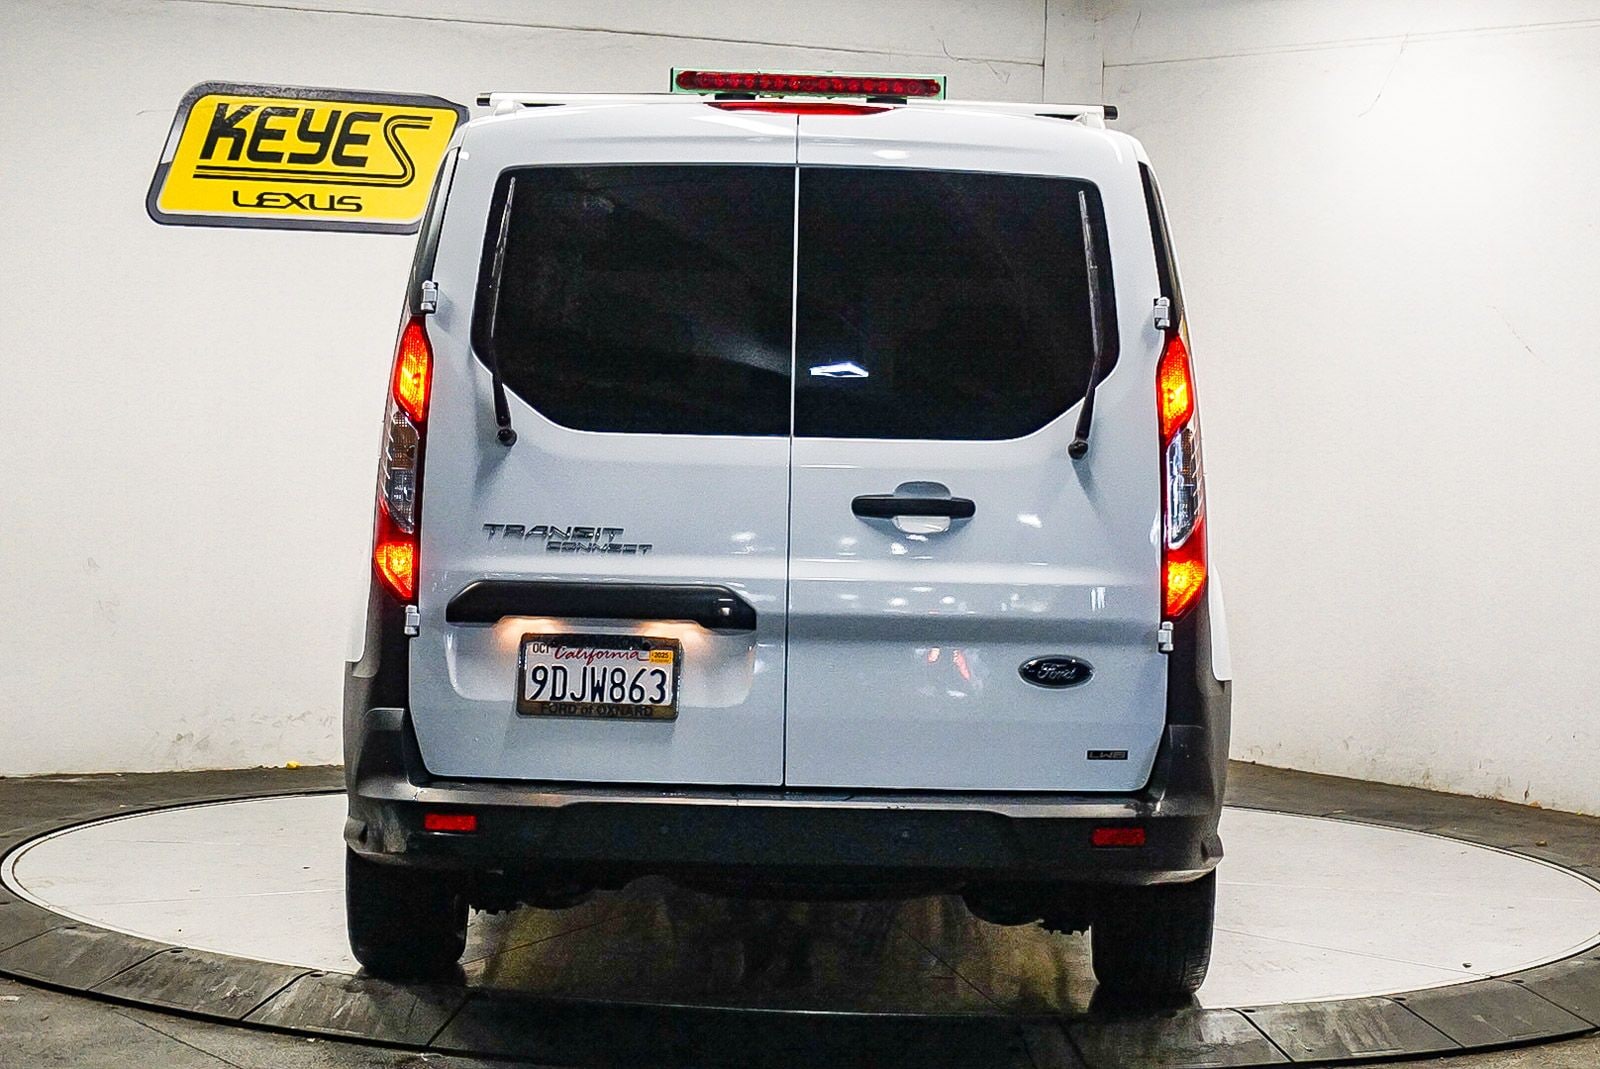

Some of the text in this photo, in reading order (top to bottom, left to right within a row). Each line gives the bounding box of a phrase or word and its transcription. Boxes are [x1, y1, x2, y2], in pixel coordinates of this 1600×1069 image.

[193, 102, 433, 188] KEYES
[232, 190, 363, 212] LEXUS
[483, 523, 624, 541] TRANSIT
[546, 541, 653, 555] CONNECT
[532, 643, 550, 653] OCT
[554, 645, 649, 666] California
[1037, 662, 1077, 680] Ford
[530, 665, 667, 703] 9DJW863
[540, 703, 577, 714] FORD
[596, 704, 655, 717] OXNARD
